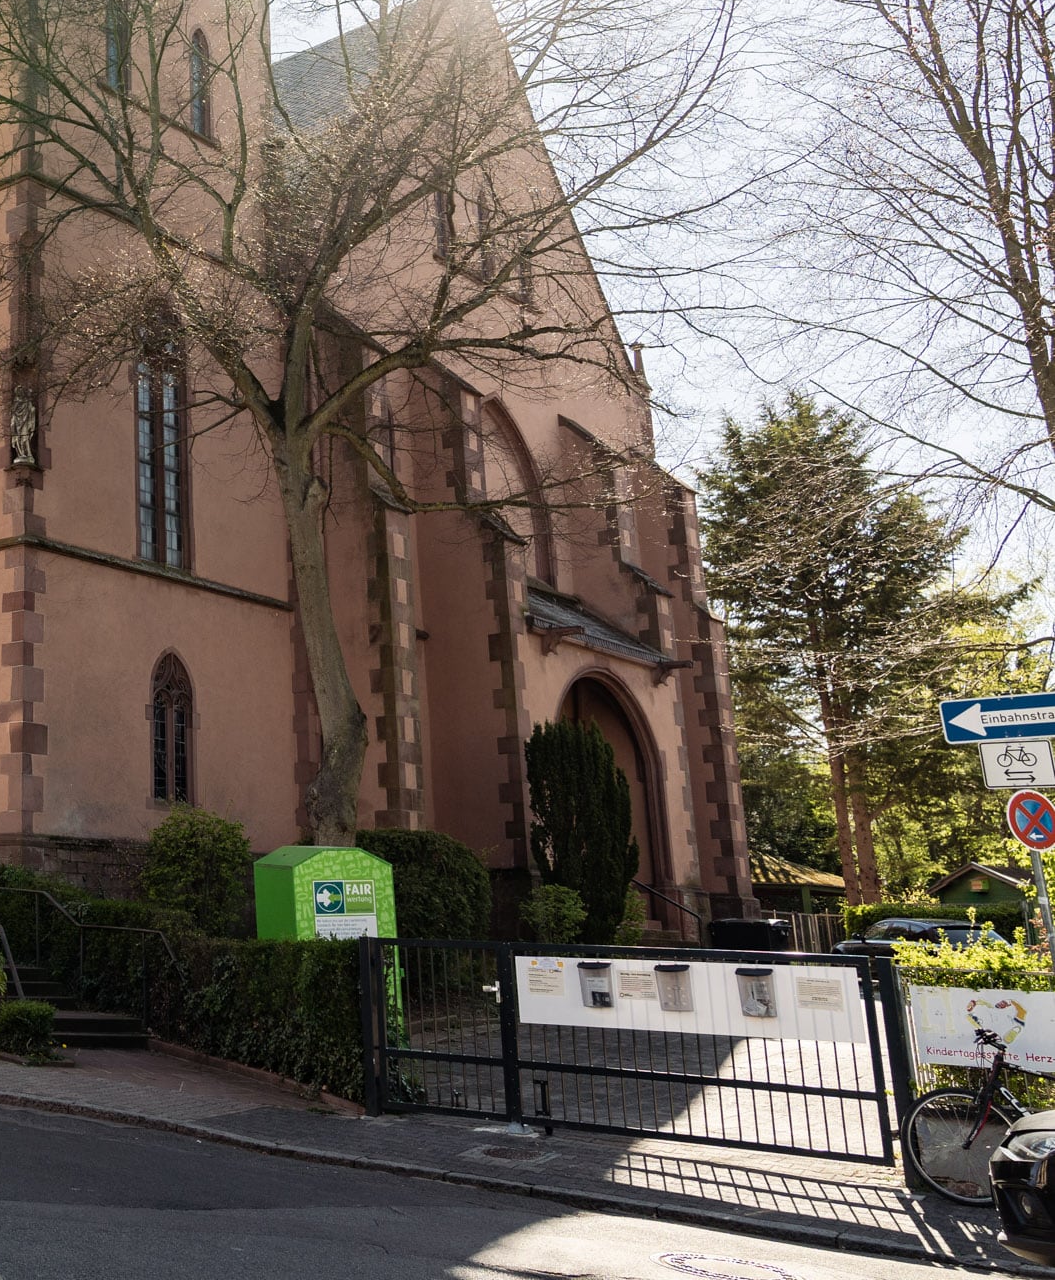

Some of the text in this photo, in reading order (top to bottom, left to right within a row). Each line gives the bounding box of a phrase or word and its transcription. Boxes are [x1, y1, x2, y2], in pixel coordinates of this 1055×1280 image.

[346, 883, 371, 895] FAIR
[347, 896, 372, 904] wertung
[926, 1046, 1020, 1061] Kindertagessttte
